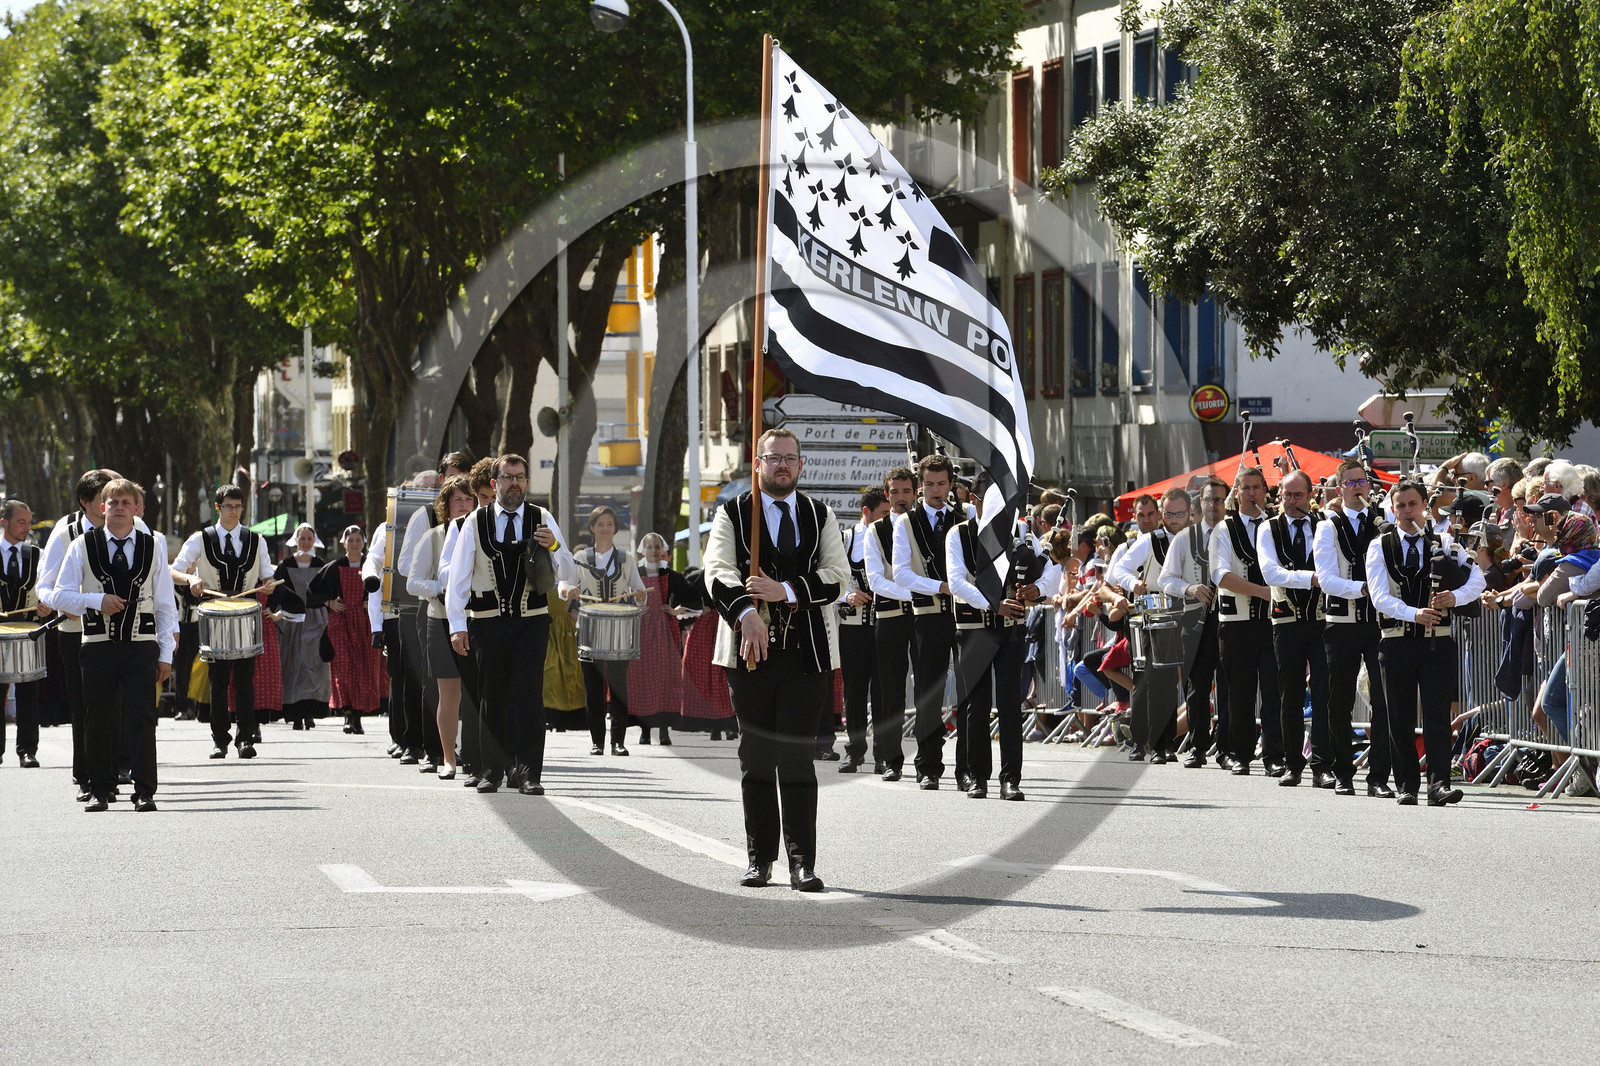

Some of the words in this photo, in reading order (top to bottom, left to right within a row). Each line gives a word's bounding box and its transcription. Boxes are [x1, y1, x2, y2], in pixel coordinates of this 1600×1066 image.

[799, 232, 950, 337] KERLENN
[966, 321, 1011, 371] PO
[1194, 399, 1226, 411] PELFORTH
[804, 427, 835, 438] Port
[845, 428, 860, 439] de
[869, 428, 903, 440] Pêch
[1403, 437, 1455, 446] PT-LOUIS
[1403, 447, 1460, 455] PZH-LOEIZ
[801, 455, 847, 467] Douanes
[800, 469, 847, 481] Affaires
[850, 469, 888, 481] Mariti
